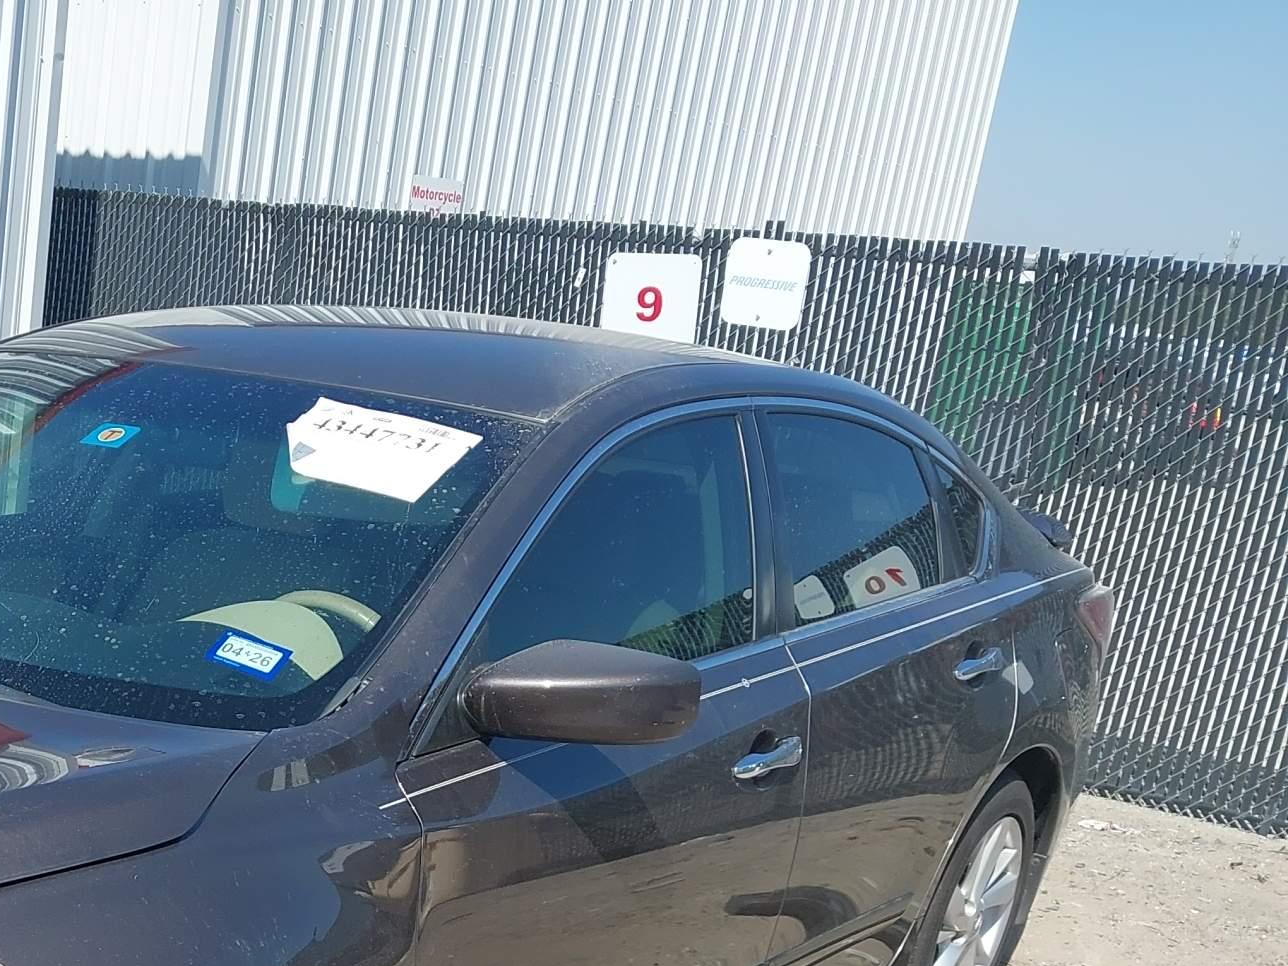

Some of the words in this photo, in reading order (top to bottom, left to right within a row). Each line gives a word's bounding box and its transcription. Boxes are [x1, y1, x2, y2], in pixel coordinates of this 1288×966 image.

[412, 185, 462, 205] Motorcycle
[729, 275, 798, 292] PROGRESSIVE
[636, 286, 663, 322] 9
